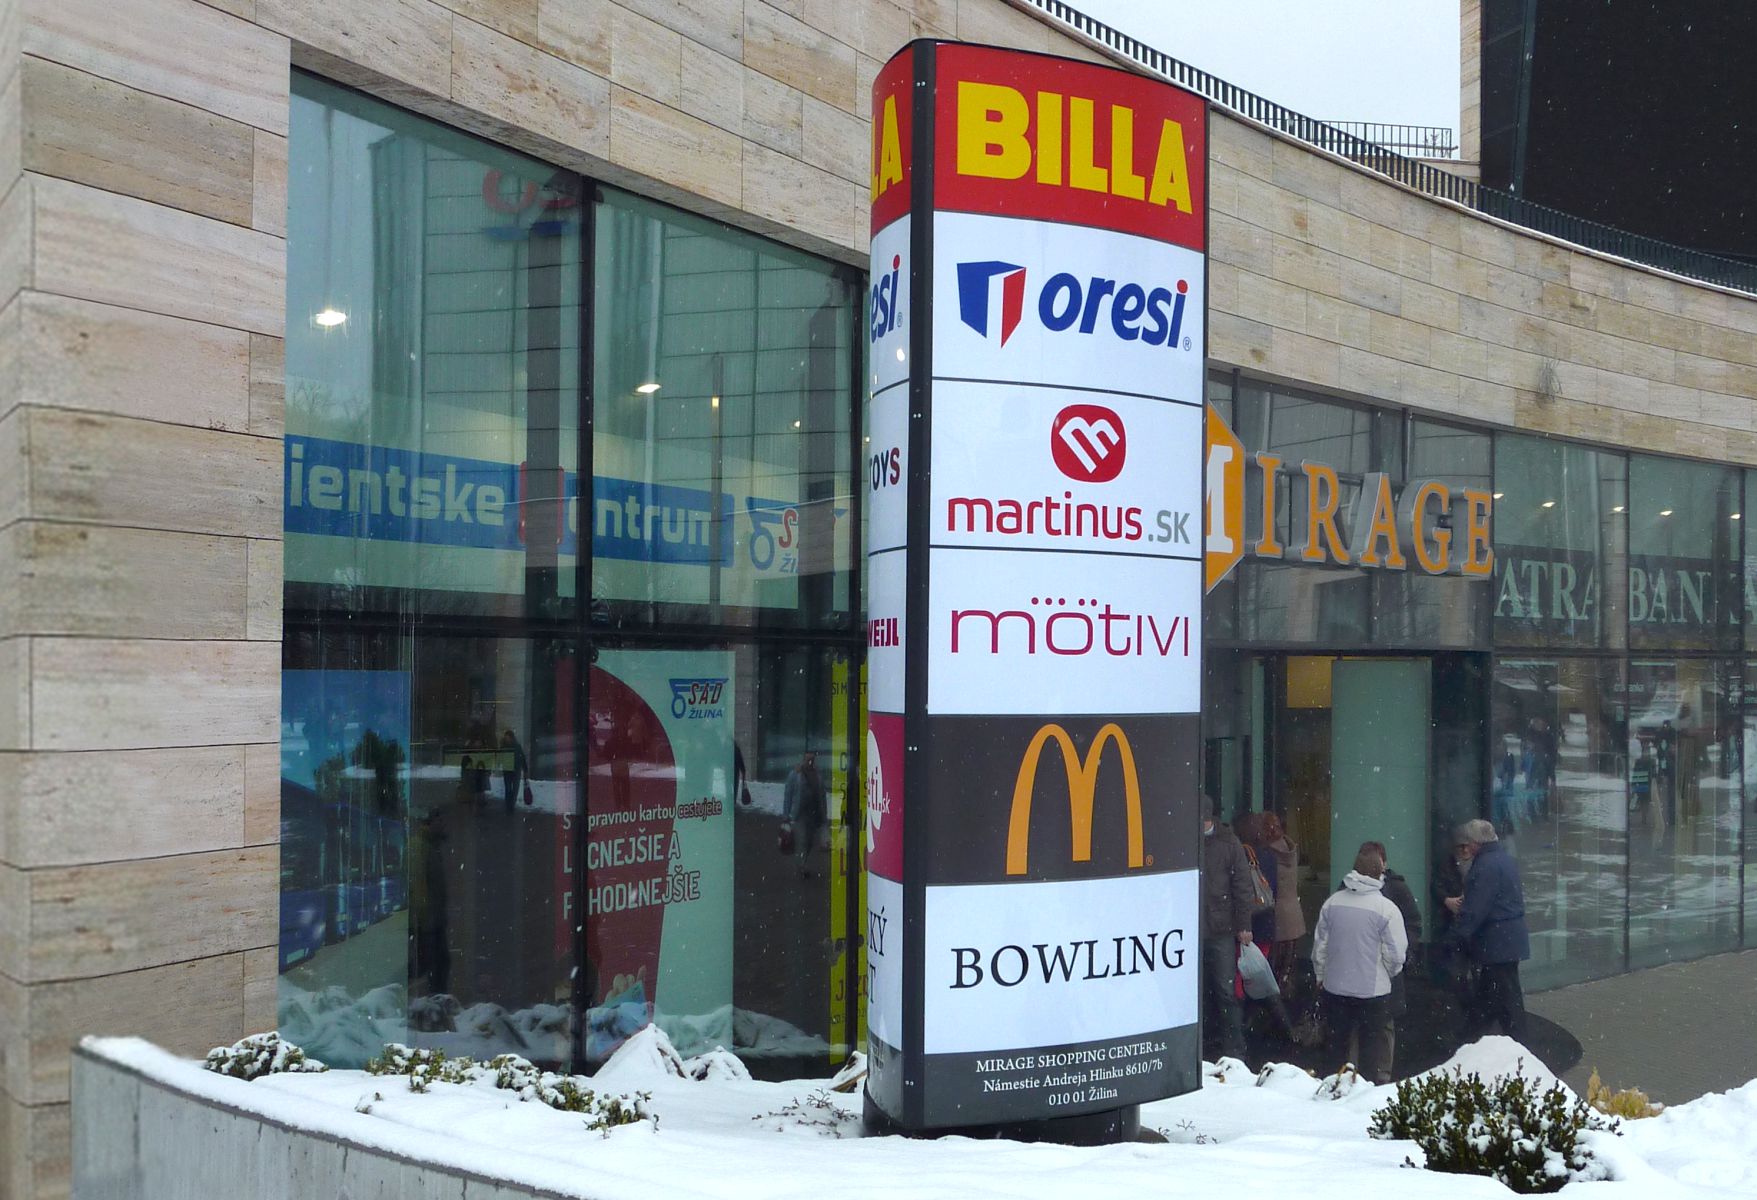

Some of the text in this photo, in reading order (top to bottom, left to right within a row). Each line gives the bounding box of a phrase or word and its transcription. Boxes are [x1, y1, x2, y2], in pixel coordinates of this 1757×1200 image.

[956, 80, 1193, 215] BILLA
[1038, 272, 1189, 349] oresi
[290, 443, 504, 526] ientske
[569, 496, 711, 546] ntrum
[1494, 557, 1757, 625] ATR BANA
[688, 682, 723, 705] SAD
[688, 707, 723, 719] ŽILINA
[588, 809, 636, 832] pravnou
[639, 803, 676, 824] kartou
[678, 797, 722, 822] cestujete
[564, 828, 681, 873] LCNEJŠIE A
[564, 865, 700, 920] PHODLNEJŠIE
[949, 928, 1185, 989] BOWLING
[975, 1041, 1168, 1073] MIRAGE SHOPPING CENTER a.s.
[983, 1058, 1163, 1093] Námestie Andreja Hlinku 8610/7b
[1048, 1086, 1118, 1106] 010 01 Žilina
